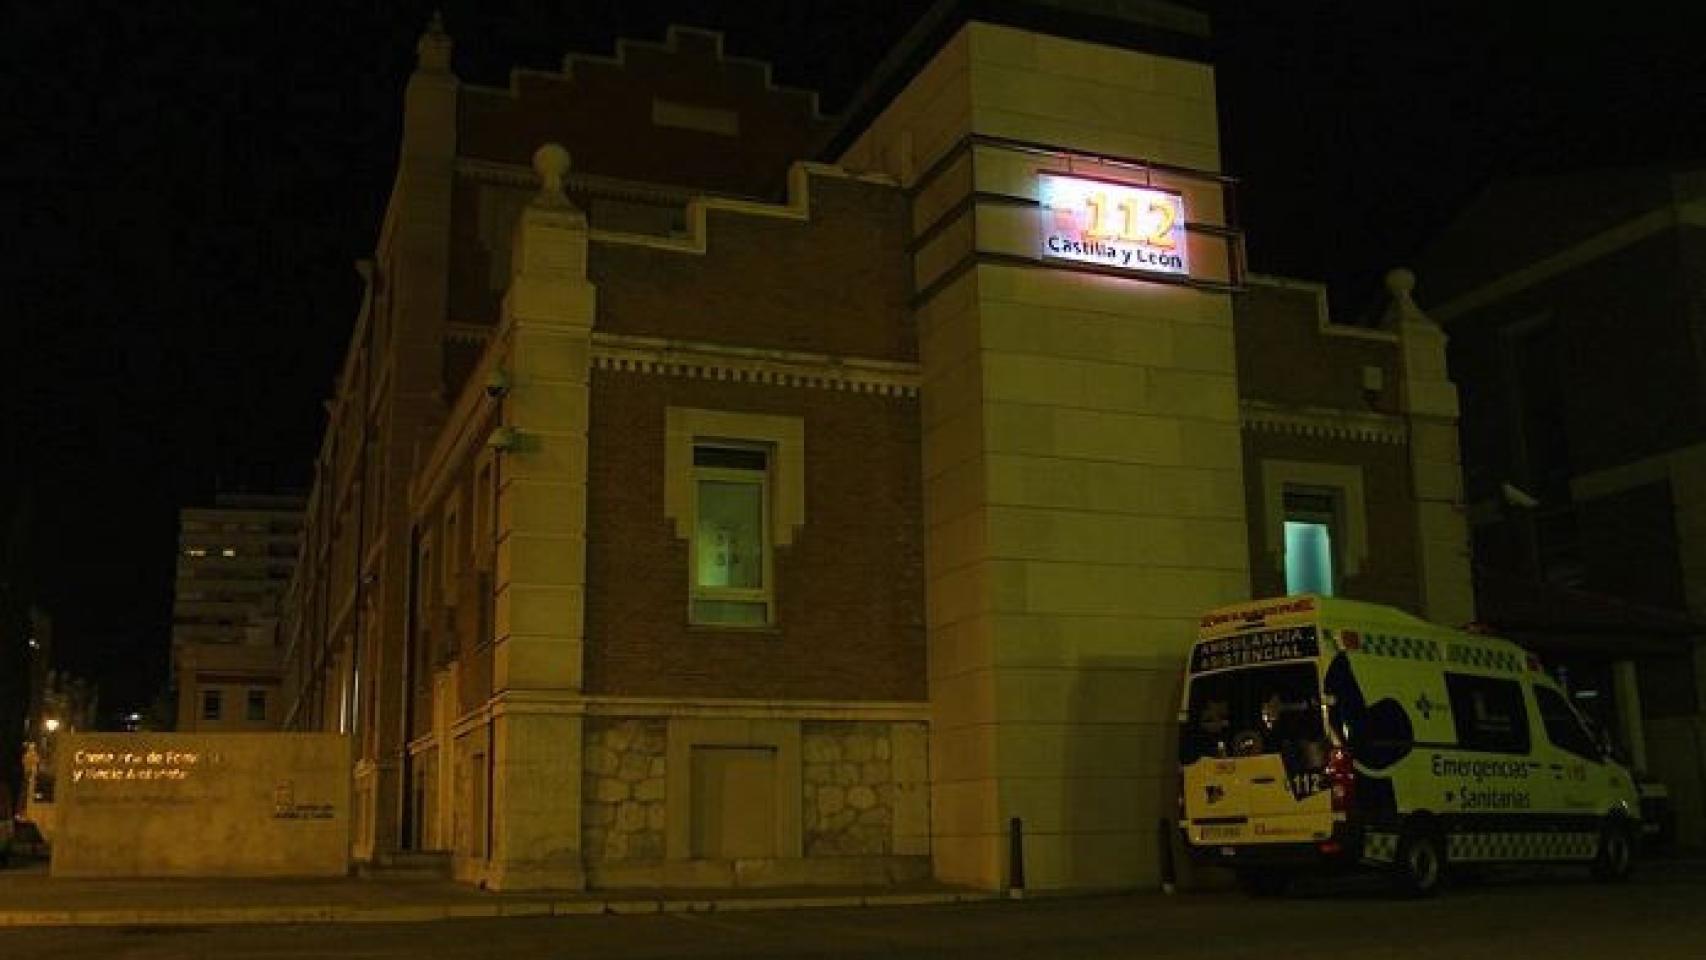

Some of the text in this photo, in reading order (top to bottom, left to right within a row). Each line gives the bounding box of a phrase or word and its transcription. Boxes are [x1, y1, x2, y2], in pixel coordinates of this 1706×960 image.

[1081, 191, 1177, 250] 112
[1048, 234, 1183, 269] Castilla y León
[1431, 754, 1530, 783] Emergencias
[1460, 785, 1531, 810] Sanitarias
